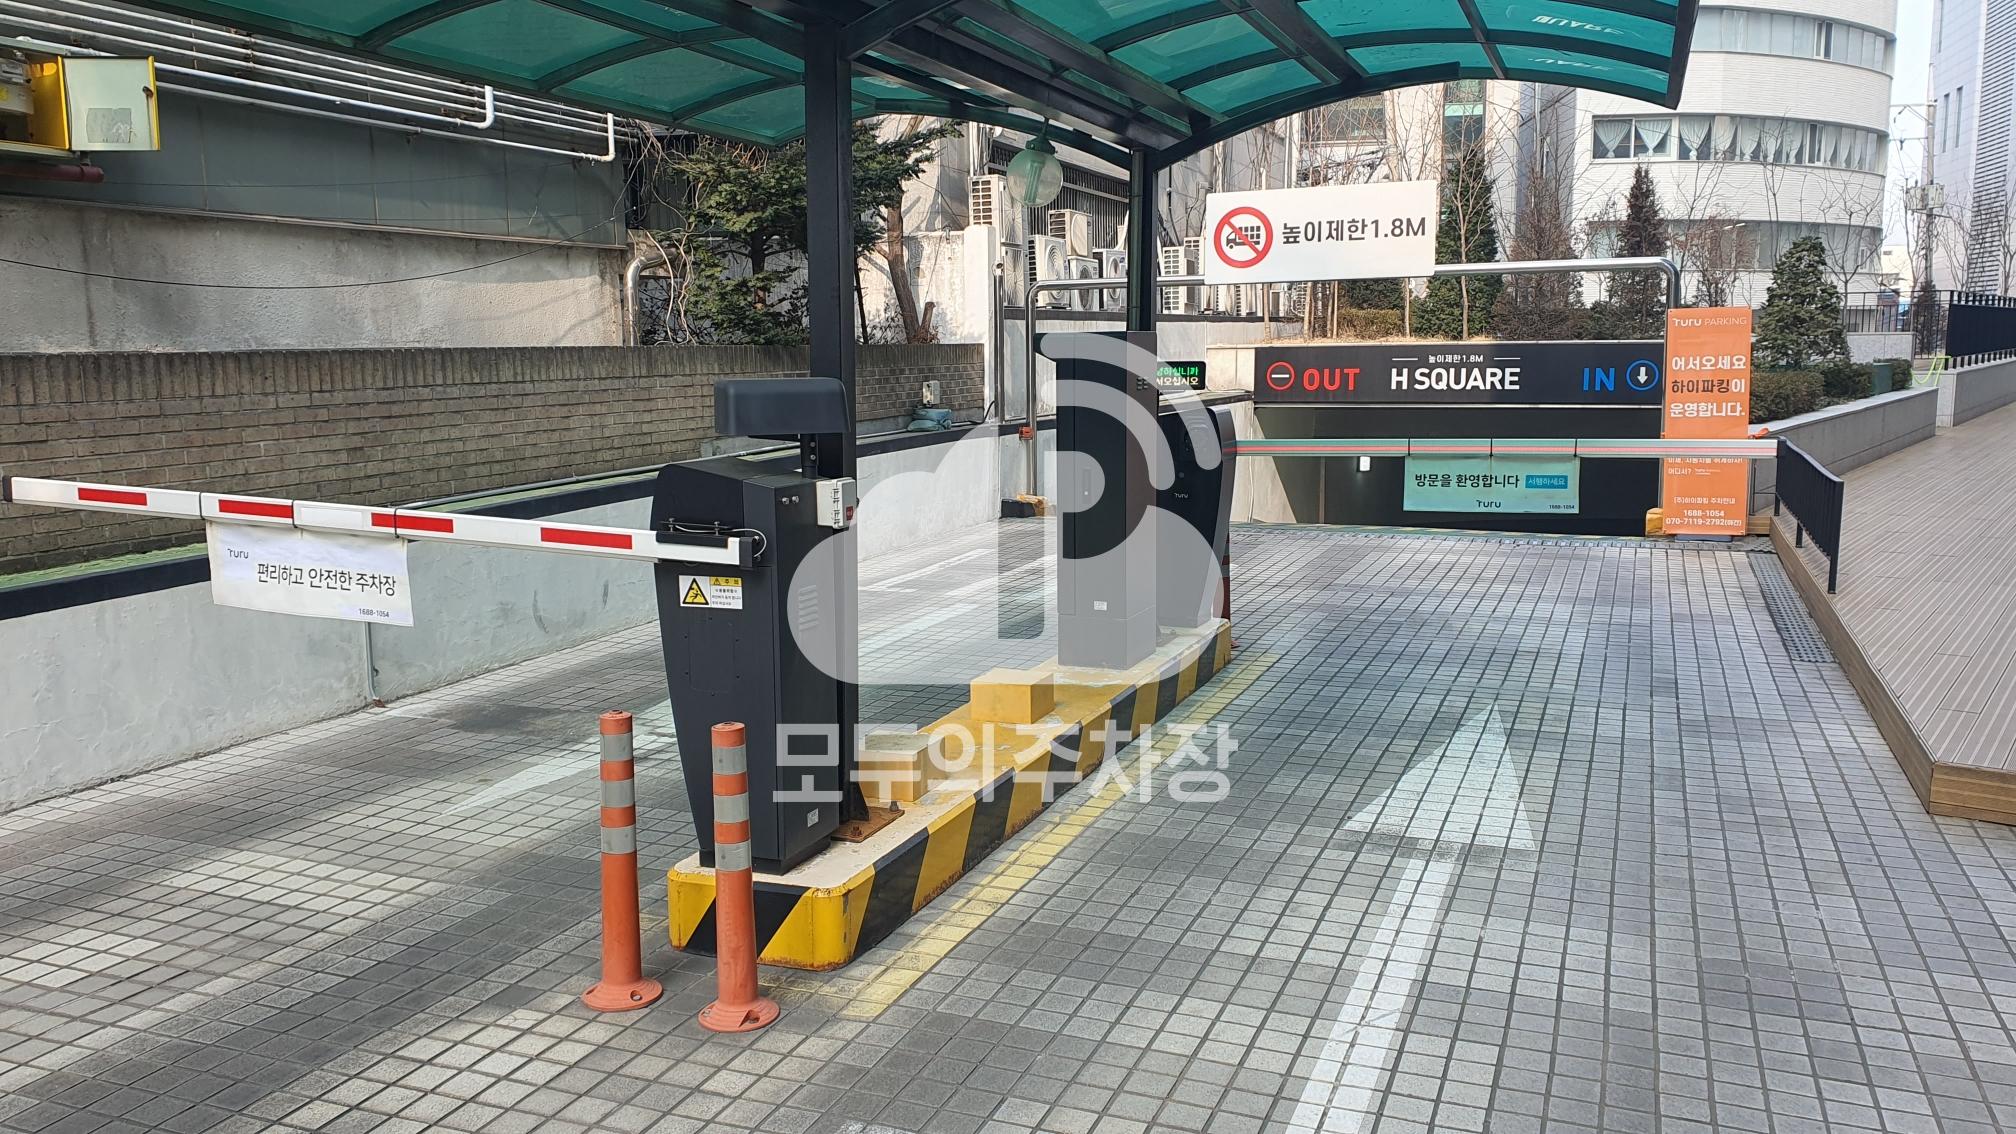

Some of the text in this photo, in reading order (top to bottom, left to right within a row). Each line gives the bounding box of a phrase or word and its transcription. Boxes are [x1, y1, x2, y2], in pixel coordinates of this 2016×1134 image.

[1282, 217, 1426, 245] 높이제한1.8M
[1704, 316, 1747, 326] PARKING
[1428, 354, 1484, 364] 높이제한1.8M
[1671, 355, 1747, 371] 어서오세요
[1303, 368, 1361, 392] OUT
[1391, 367, 1521, 392] H SQUARE
[1582, 367, 1616, 392] IN
[1671, 378, 1746, 394] 하이파킹이
[1669, 402, 1746, 418] 운영합니다.
[1414, 473, 1520, 489] 방문을 환영합니다
[1683, 509, 1725, 517] 1688-1054
[257, 562, 397, 597] 편리하고 안전한 주차장
[358, 607, 390, 618] 1688-1054
